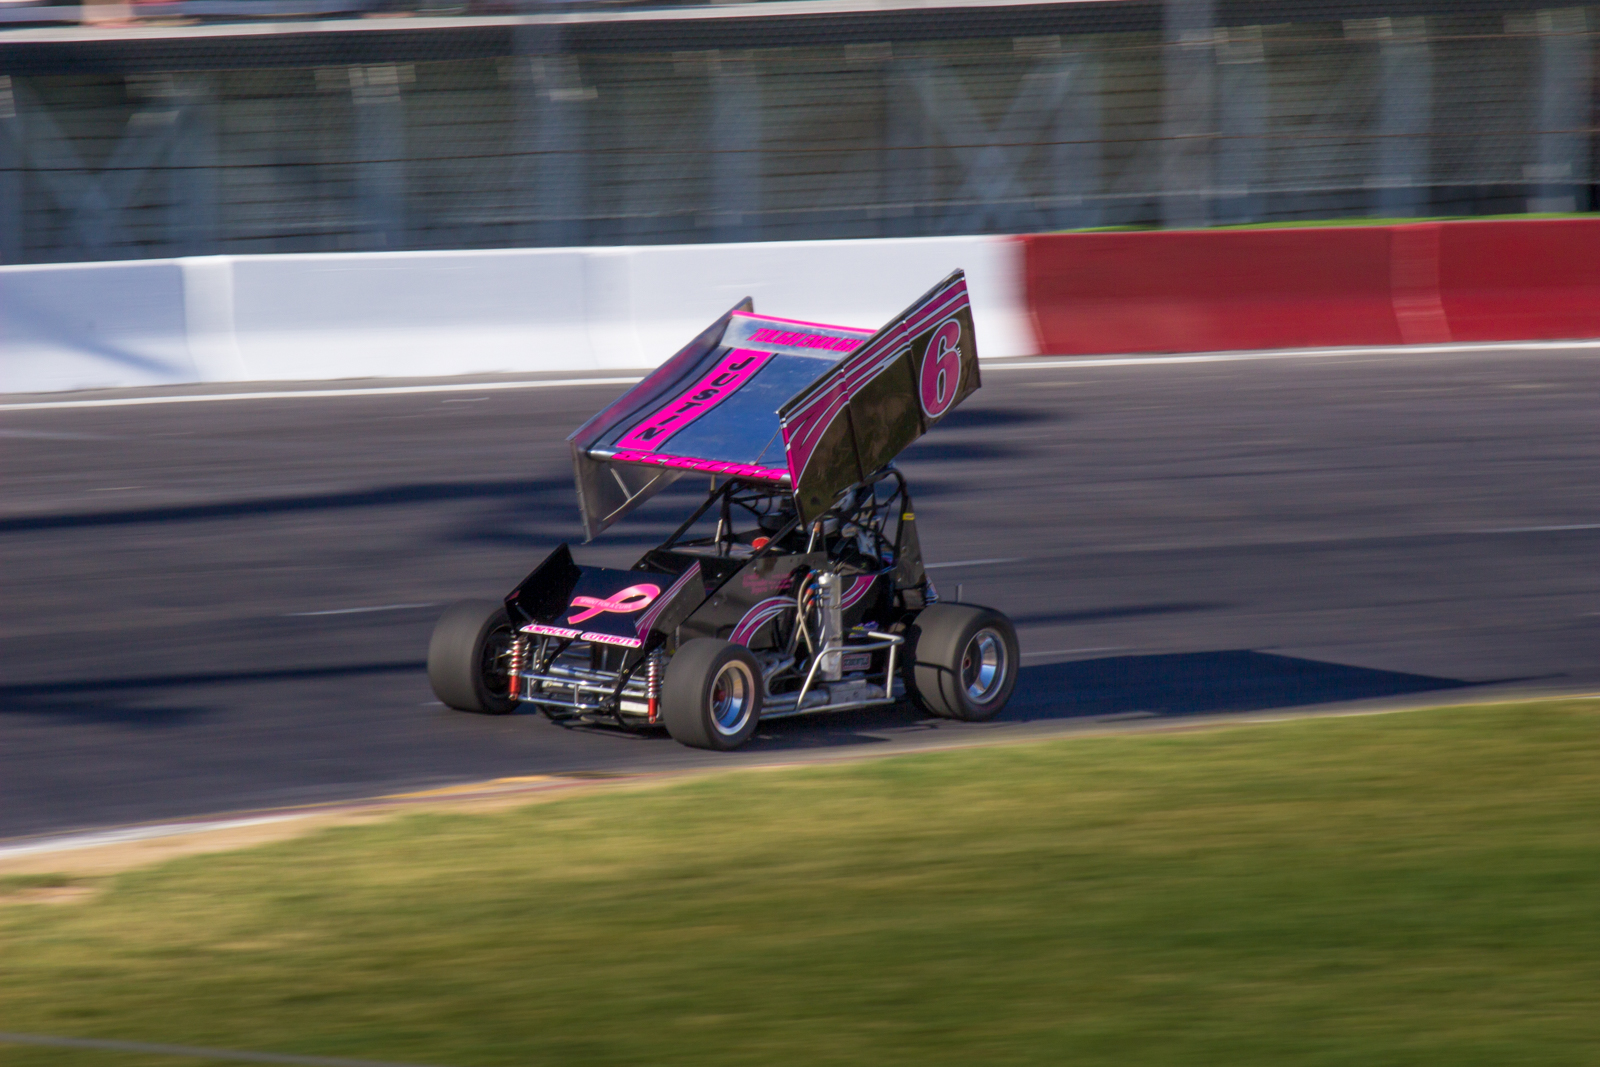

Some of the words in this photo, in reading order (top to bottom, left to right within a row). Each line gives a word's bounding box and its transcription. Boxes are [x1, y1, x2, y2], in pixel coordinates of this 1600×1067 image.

[746, 328, 806, 347] TOUGH
[795, 333, 865, 353] ENOUGH
[919, 318, 961, 418] 6
[633, 356, 757, 441] JUSTIN
[611, 450, 790, 481] SEGURA
